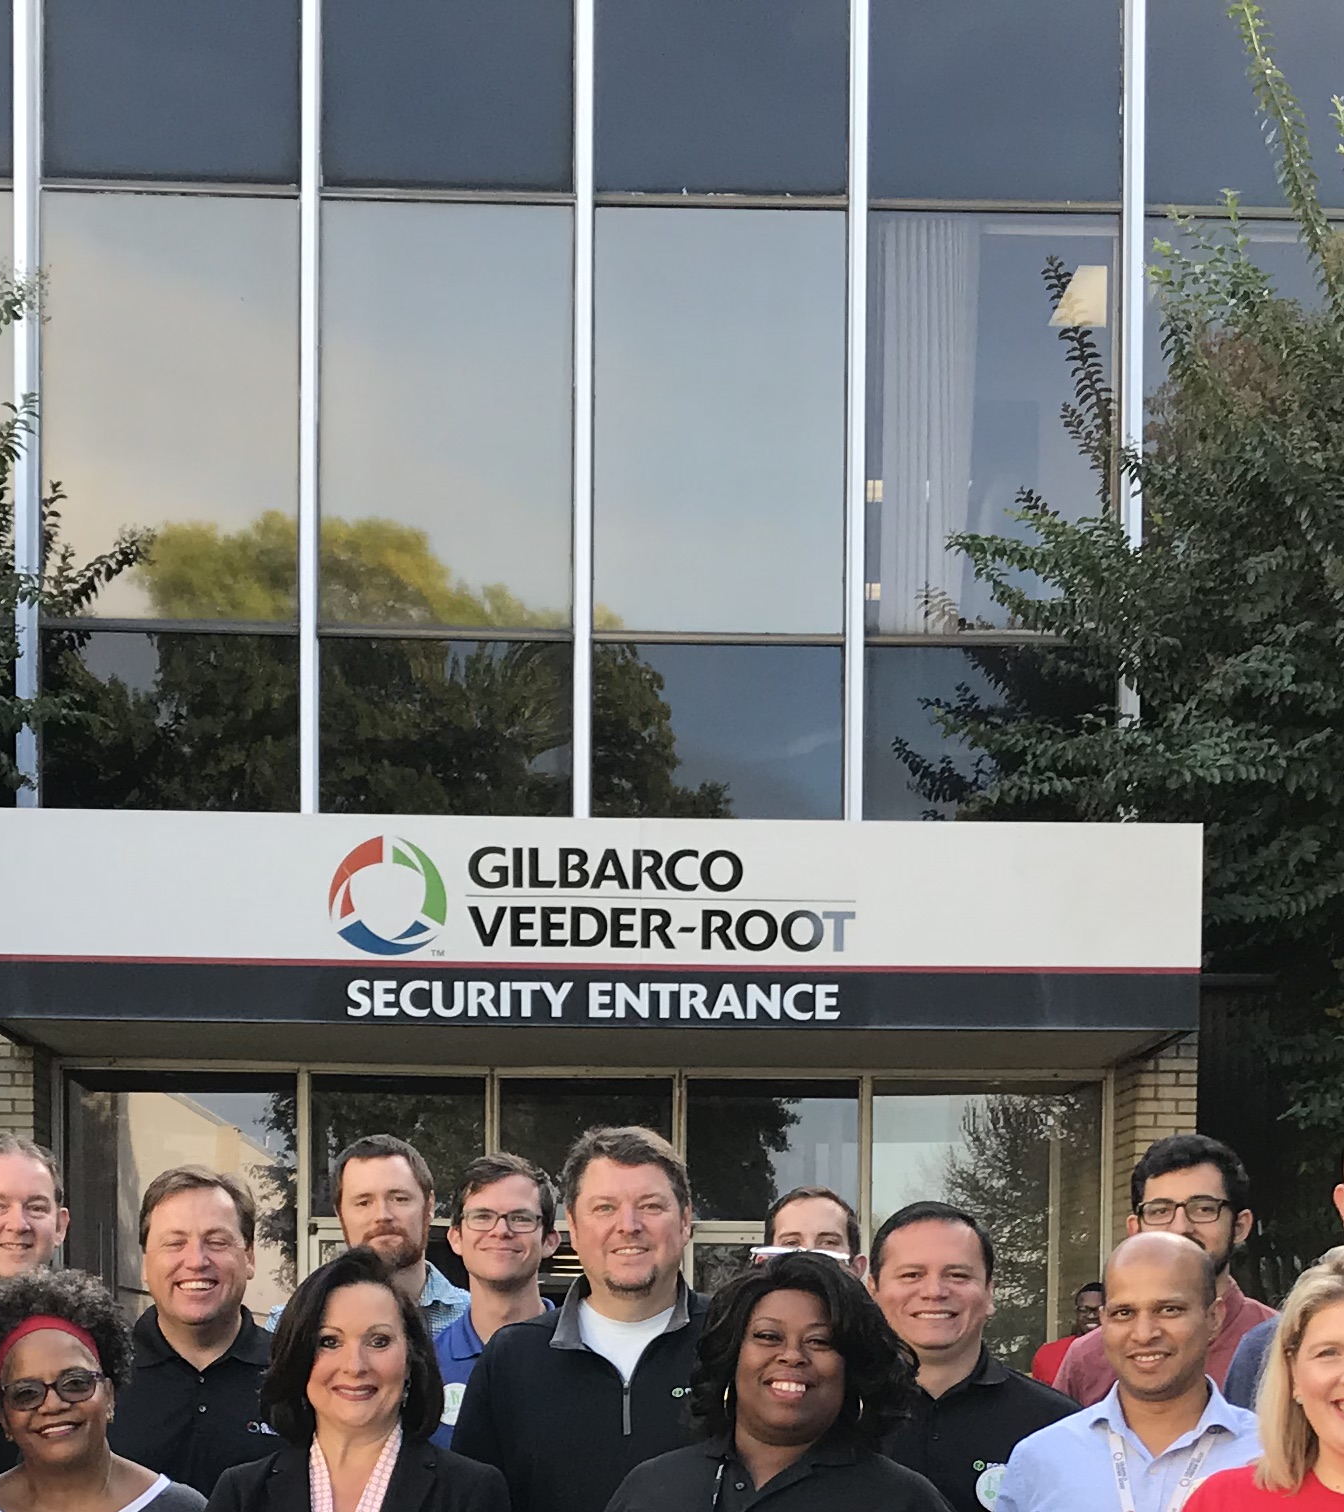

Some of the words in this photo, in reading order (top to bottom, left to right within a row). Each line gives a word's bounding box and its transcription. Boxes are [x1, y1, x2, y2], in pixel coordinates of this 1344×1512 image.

[468, 847, 744, 893] GILBARCO
[468, 904, 856, 954] VEEDER-ROOT
[430, 949, 446, 957] TM
[347, 979, 575, 1019] SECURITY
[588, 983, 842, 1022] ENTRANCE
